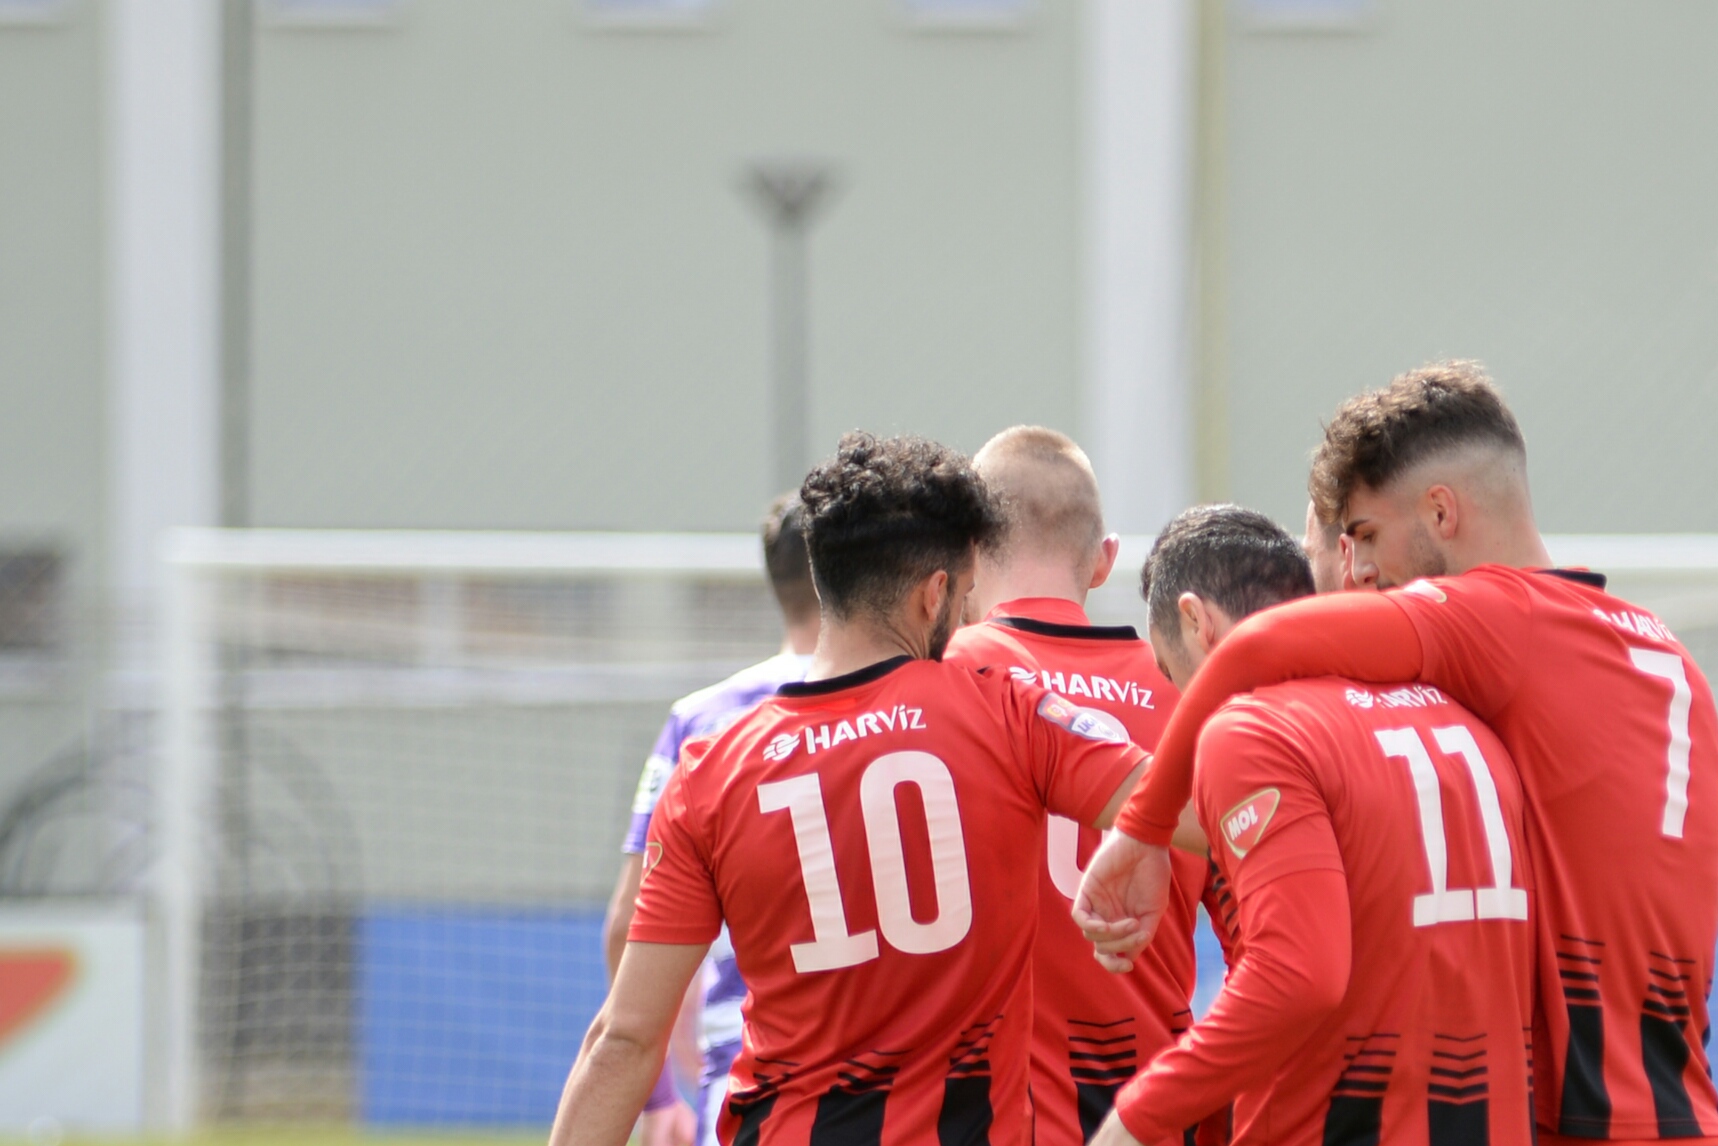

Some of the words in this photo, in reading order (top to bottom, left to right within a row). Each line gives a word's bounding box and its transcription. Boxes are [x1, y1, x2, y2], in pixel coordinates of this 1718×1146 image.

[1228, 804, 1258, 840] MOL
[1374, 725, 1528, 927] 11
[1627, 647, 1692, 839] 7
[757, 750, 973, 973] 10
